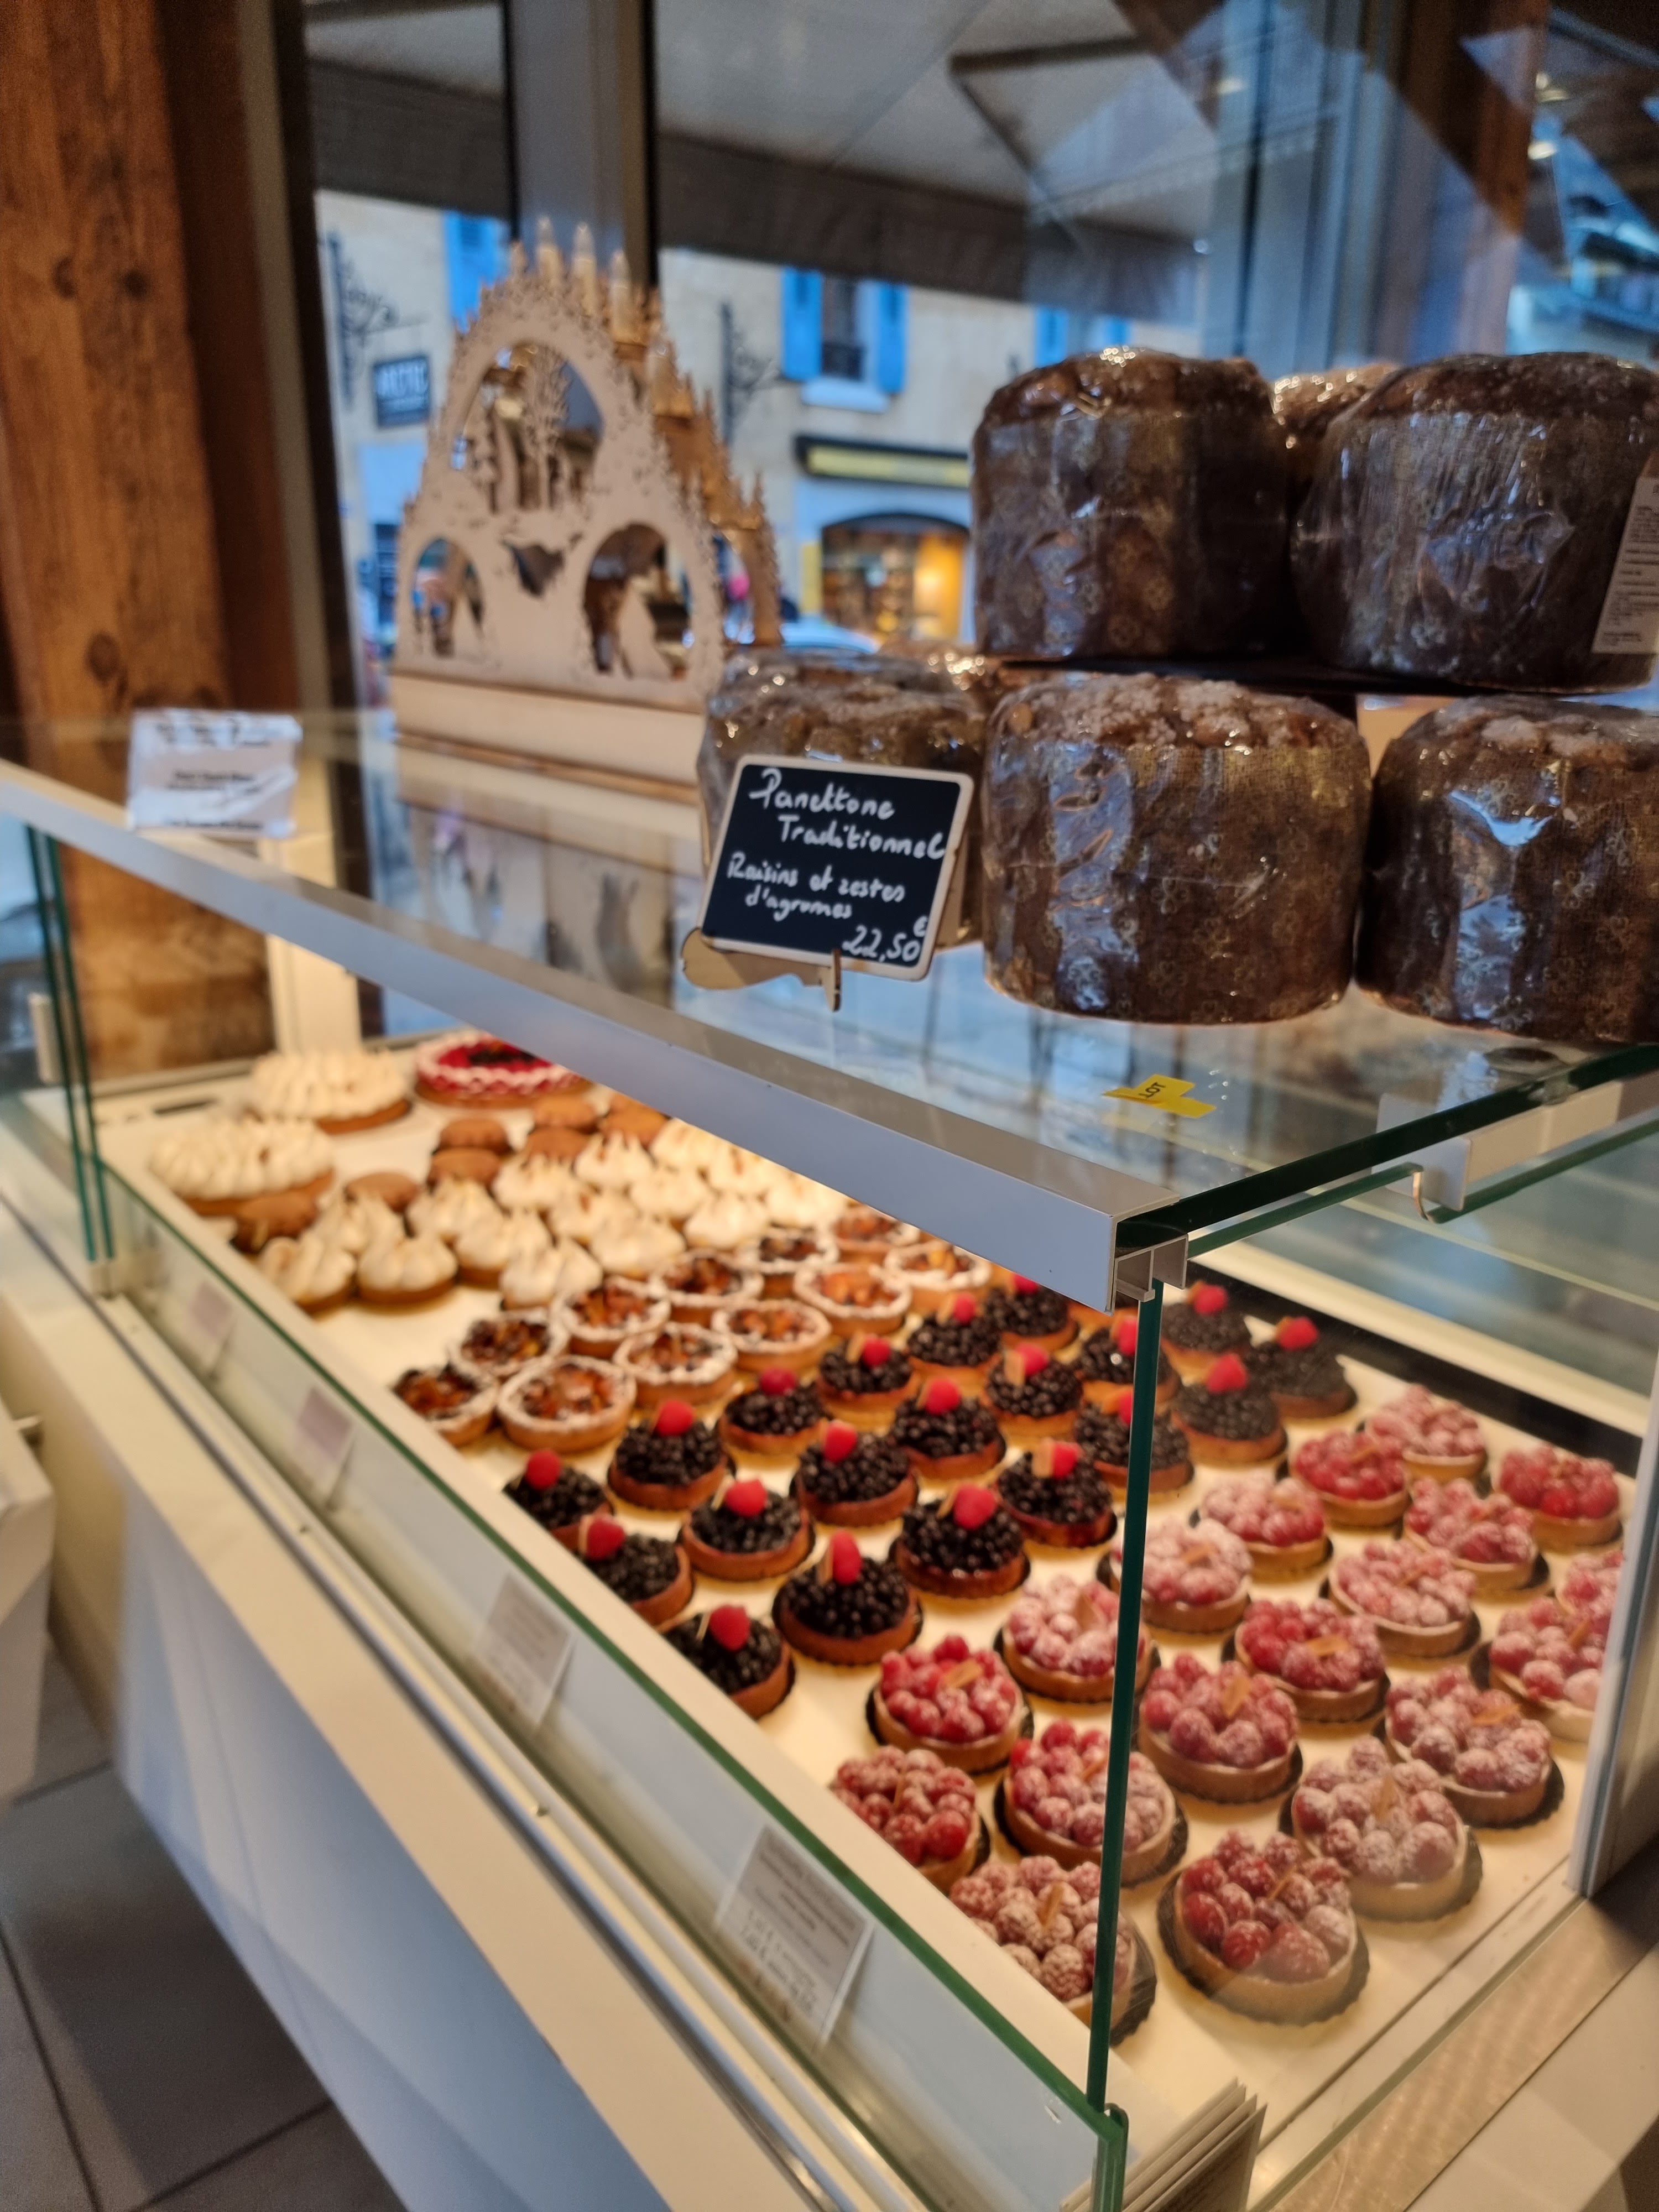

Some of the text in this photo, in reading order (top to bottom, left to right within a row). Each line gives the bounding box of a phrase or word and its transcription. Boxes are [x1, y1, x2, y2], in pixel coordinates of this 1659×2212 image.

[749, 768, 895, 819] Panettone
[778, 815, 946, 859] Traditionnel
[728, 852, 905, 902] Raisins et zestes
[745, 885, 853, 921] d'agrumes
